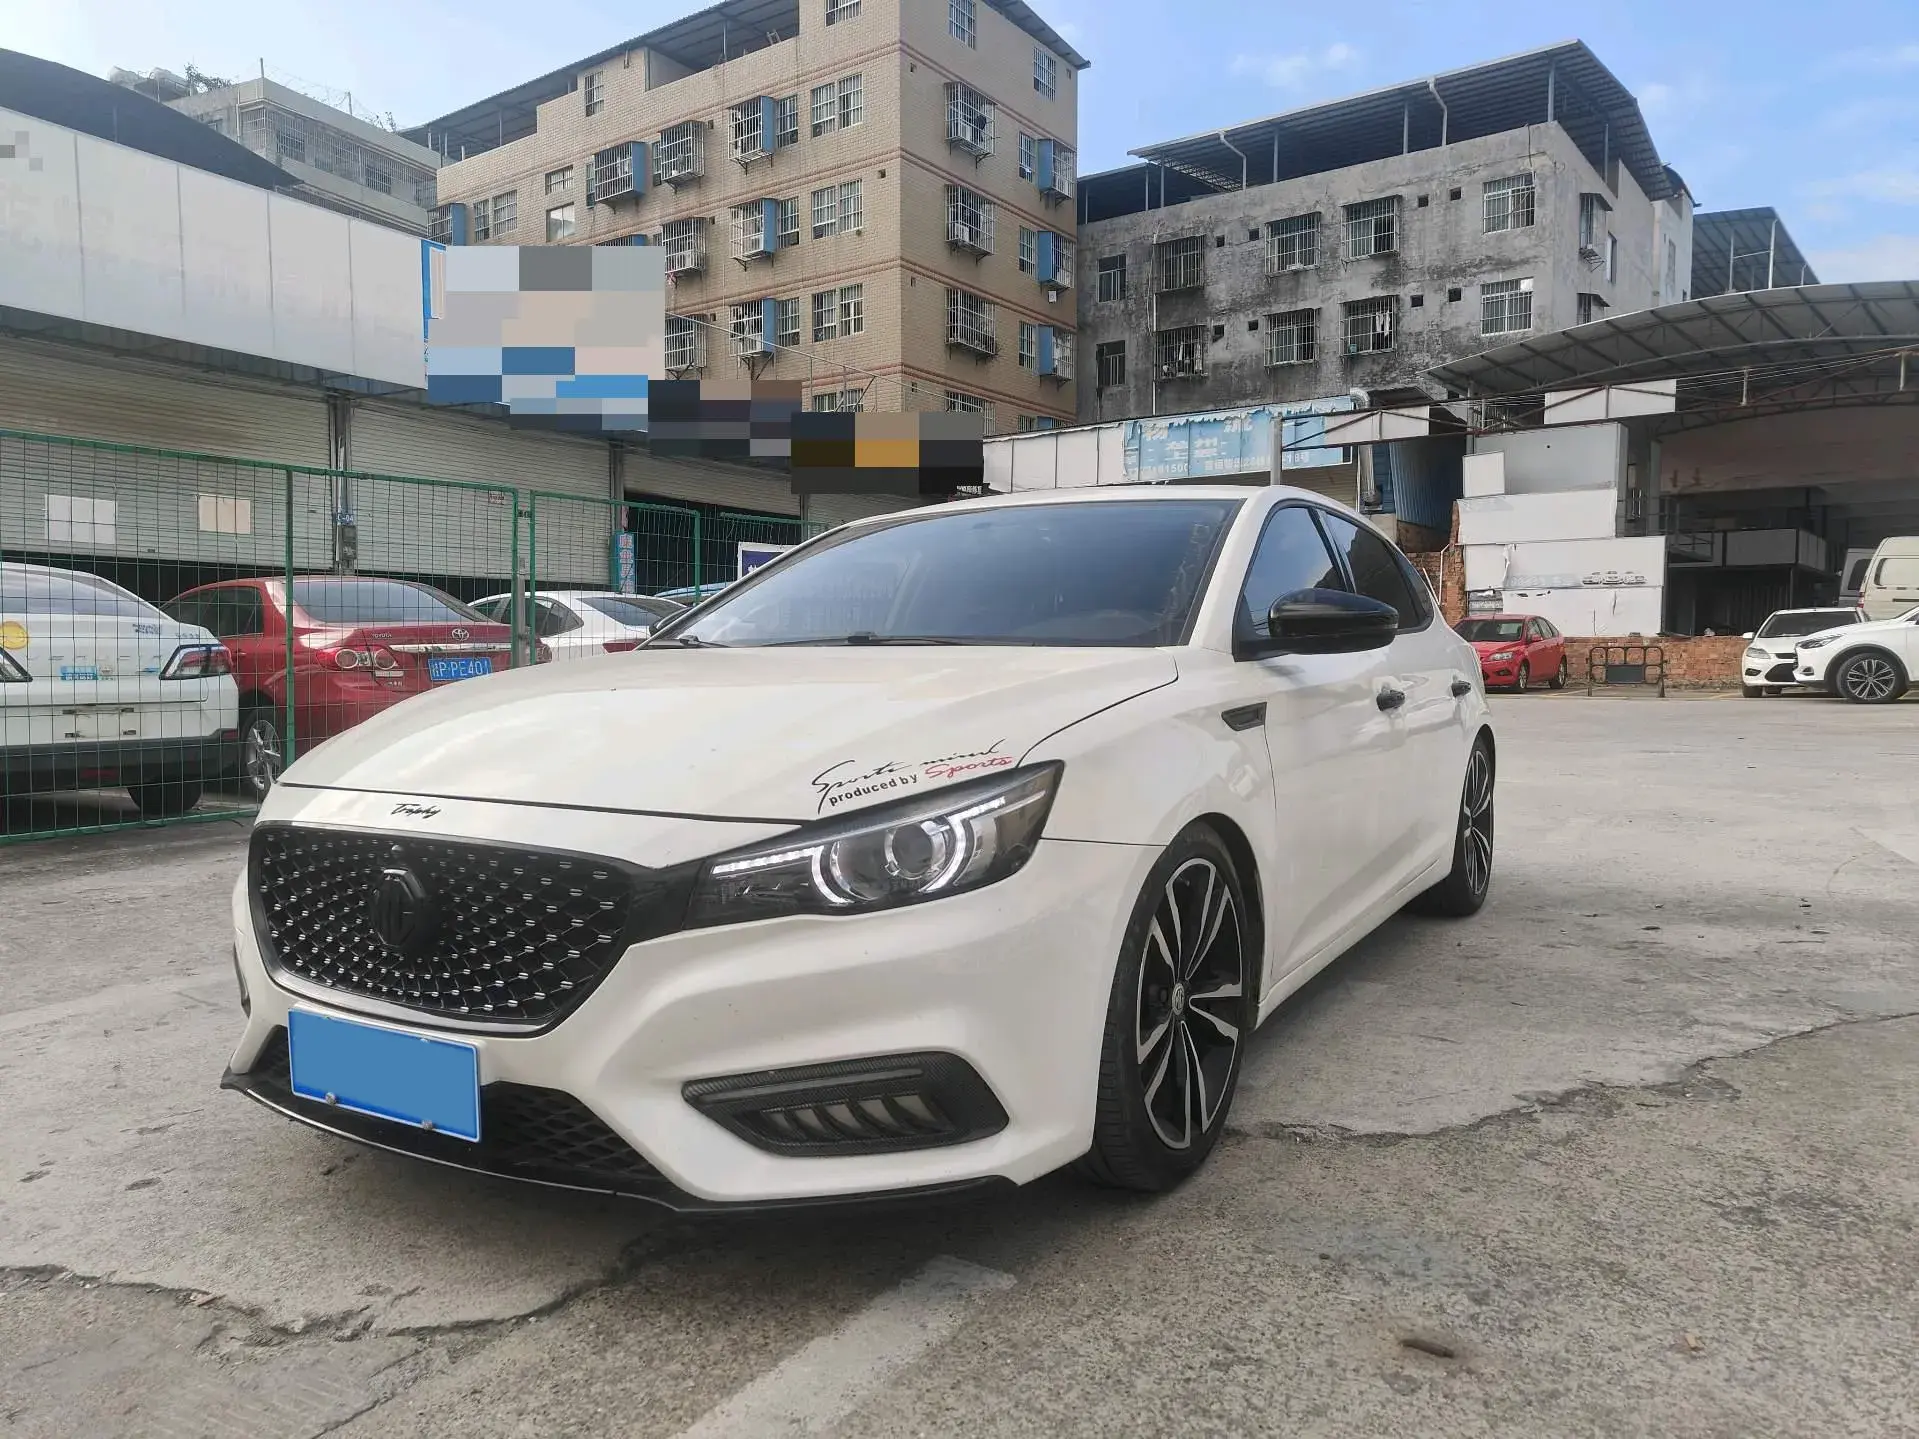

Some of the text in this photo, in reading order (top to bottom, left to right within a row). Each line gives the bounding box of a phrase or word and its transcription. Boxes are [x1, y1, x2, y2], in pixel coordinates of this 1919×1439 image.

[828, 756, 1015, 806] produced by Sports
